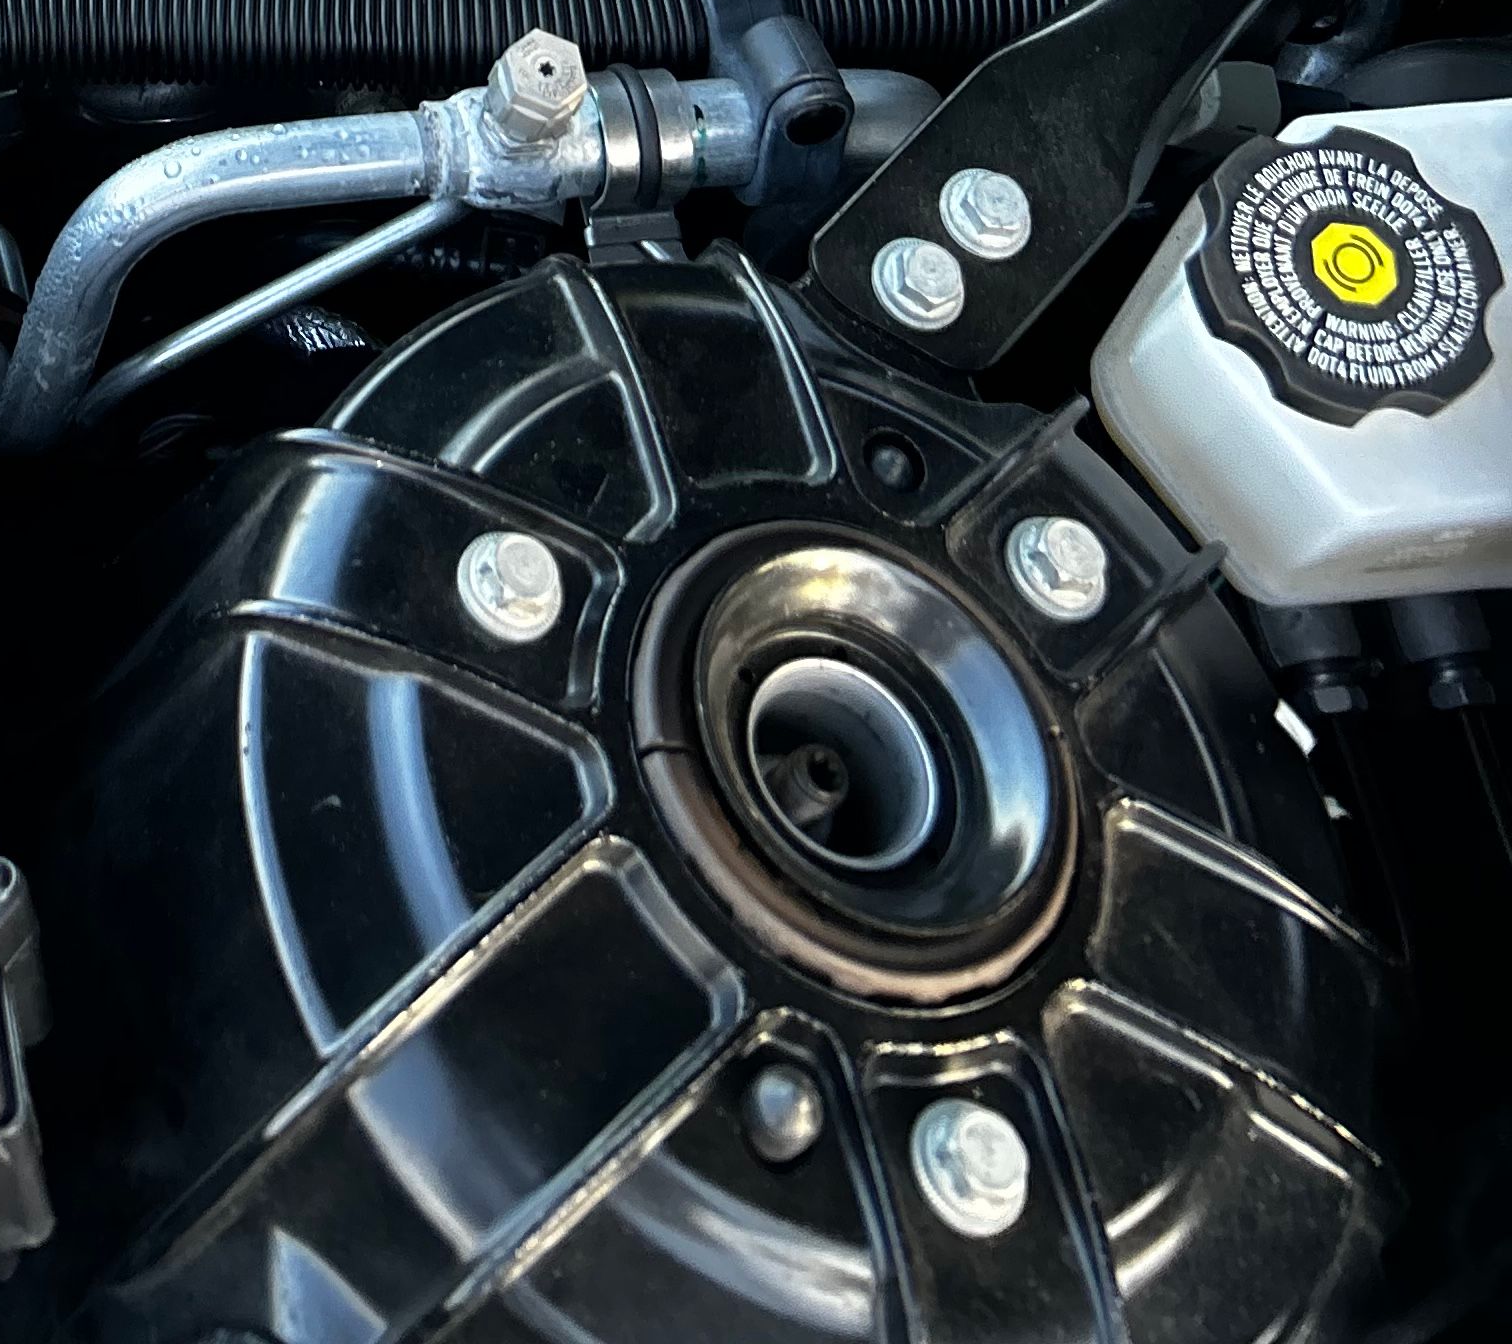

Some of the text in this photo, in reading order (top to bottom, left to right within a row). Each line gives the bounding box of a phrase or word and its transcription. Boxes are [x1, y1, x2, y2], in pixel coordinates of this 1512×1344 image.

[1254, 150, 1317, 190] BOUCHON
[1318, 148, 1364, 169] AVANT
[1367, 158, 1388, 179] LA
[1271, 169, 1323, 204] LIQUIDE
[1323, 168, 1343, 186] DE
[1347, 170, 1391, 200] FREIN
[1242, 183, 1265, 204] LE
[1258, 197, 1282, 221] DU
[1230, 200, 1255, 272] NETTOYER
[1251, 219, 1273, 249] QUE
[1420, 229, 1453, 265] ONLY
[1273, 233, 1324, 320] PROVENANT
[1301, 188, 1348, 212] BIDON
[1405, 236, 1436, 291] FILLER
[1435, 267, 1457, 297] USE
[1396, 287, 1435, 331] CLEAN
[1313, 328, 1345, 354] CAP
[1437, 307, 1476, 360] SEALED
[1345, 339, 1406, 364] BEFORE
[1431, 349, 1448, 368] A
[1349, 361, 1396, 386] FLUID
[1393, 353, 1439, 386] FROM
